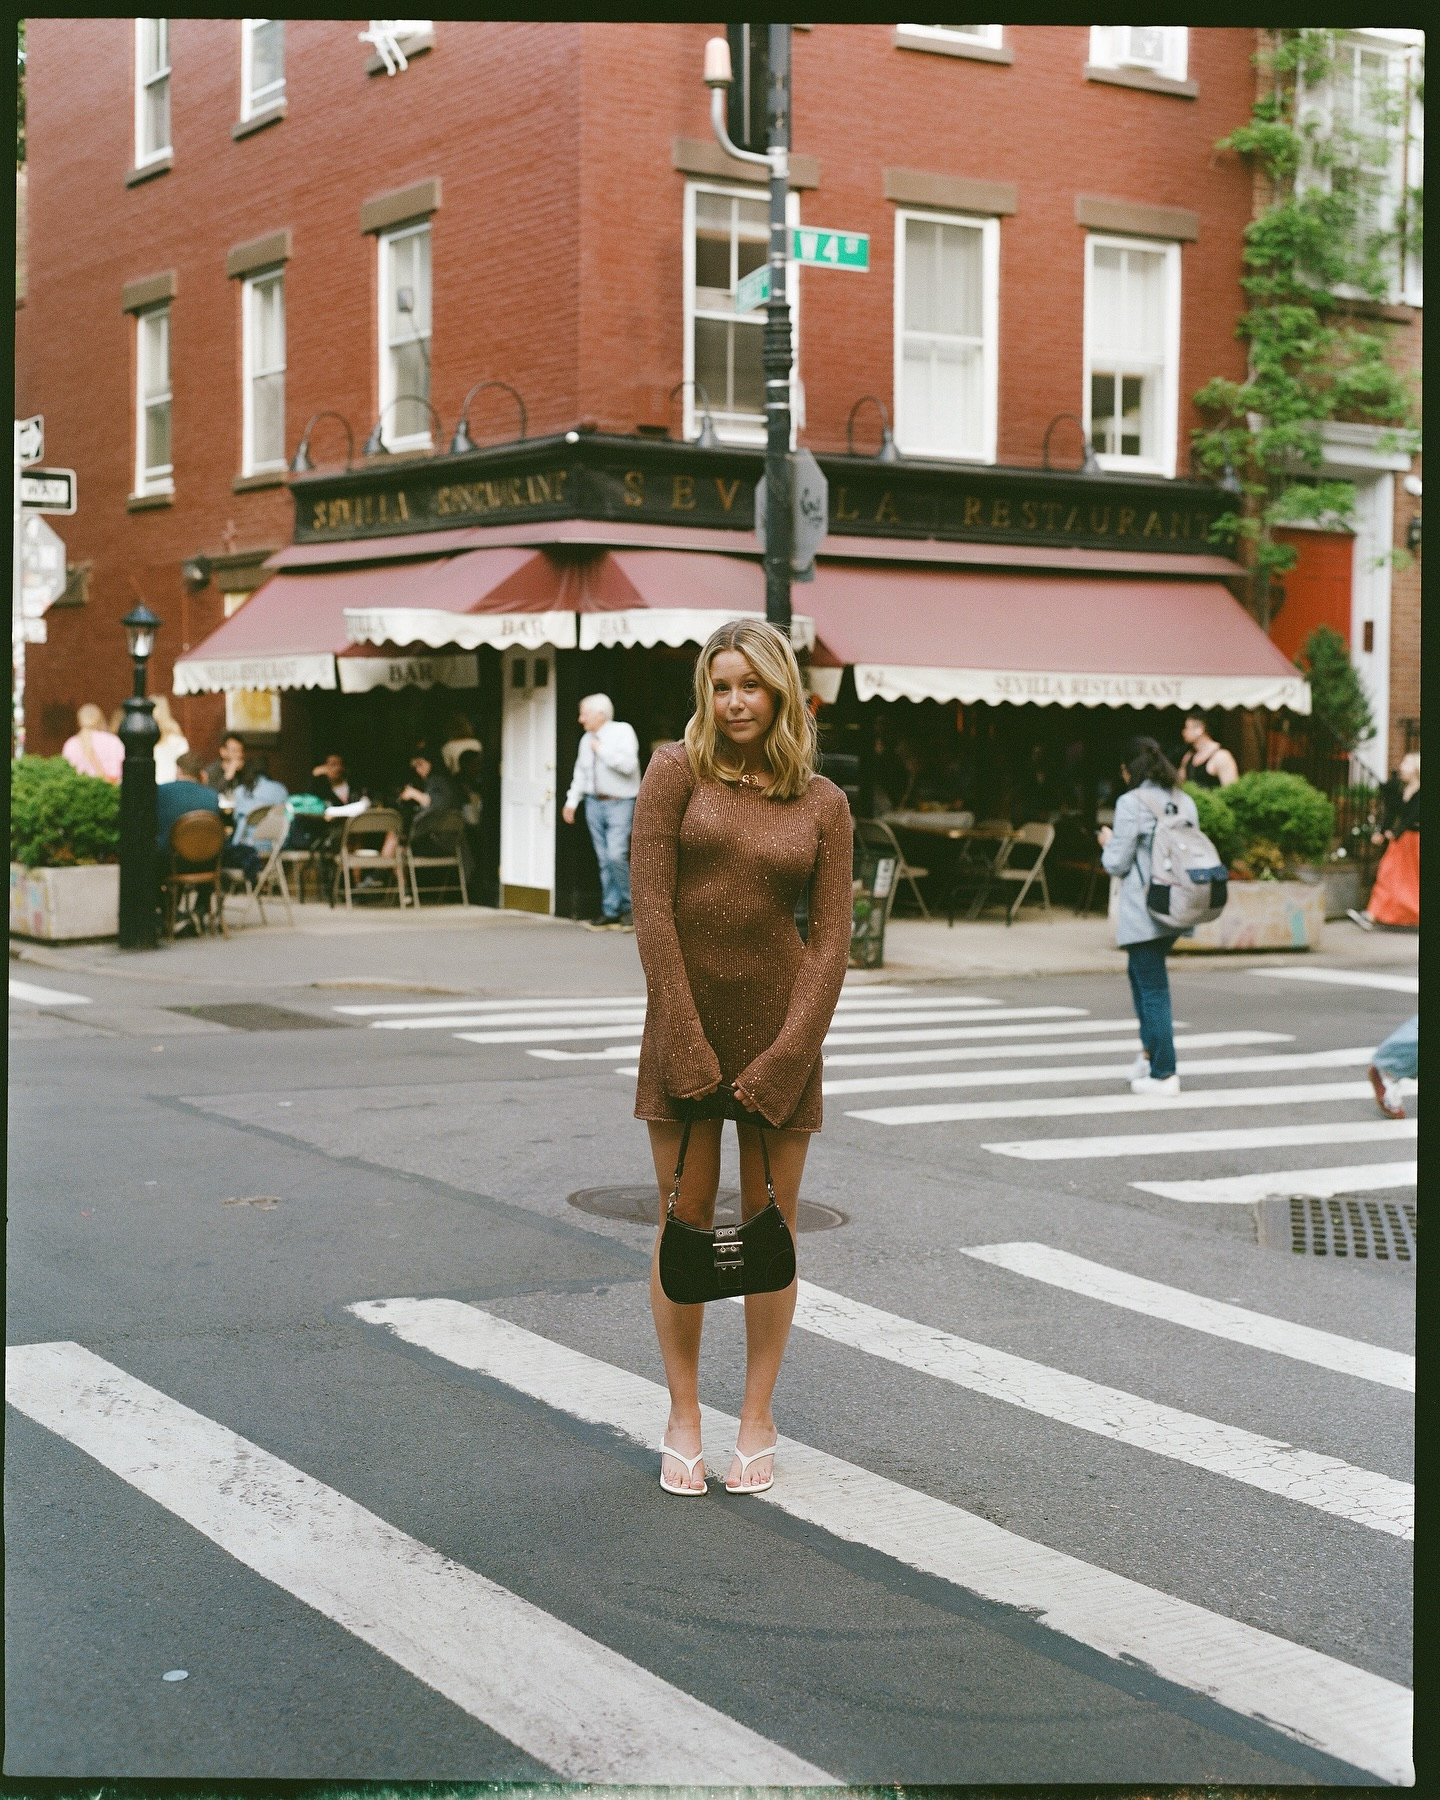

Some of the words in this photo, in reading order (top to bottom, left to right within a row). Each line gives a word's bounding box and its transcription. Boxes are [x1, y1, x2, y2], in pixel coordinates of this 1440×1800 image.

[800, 233, 818, 259] W
[823, 235, 838, 263] 4
[622, 470, 898, 524] SEVLA
[313, 492, 410, 530] SEVILLA
[501, 617, 546, 638] BAR
[389, 662, 434, 683] BAR
[995, 675, 1066, 696] SEVILLA
[1071, 678, 1183, 698] RESTAURANT
